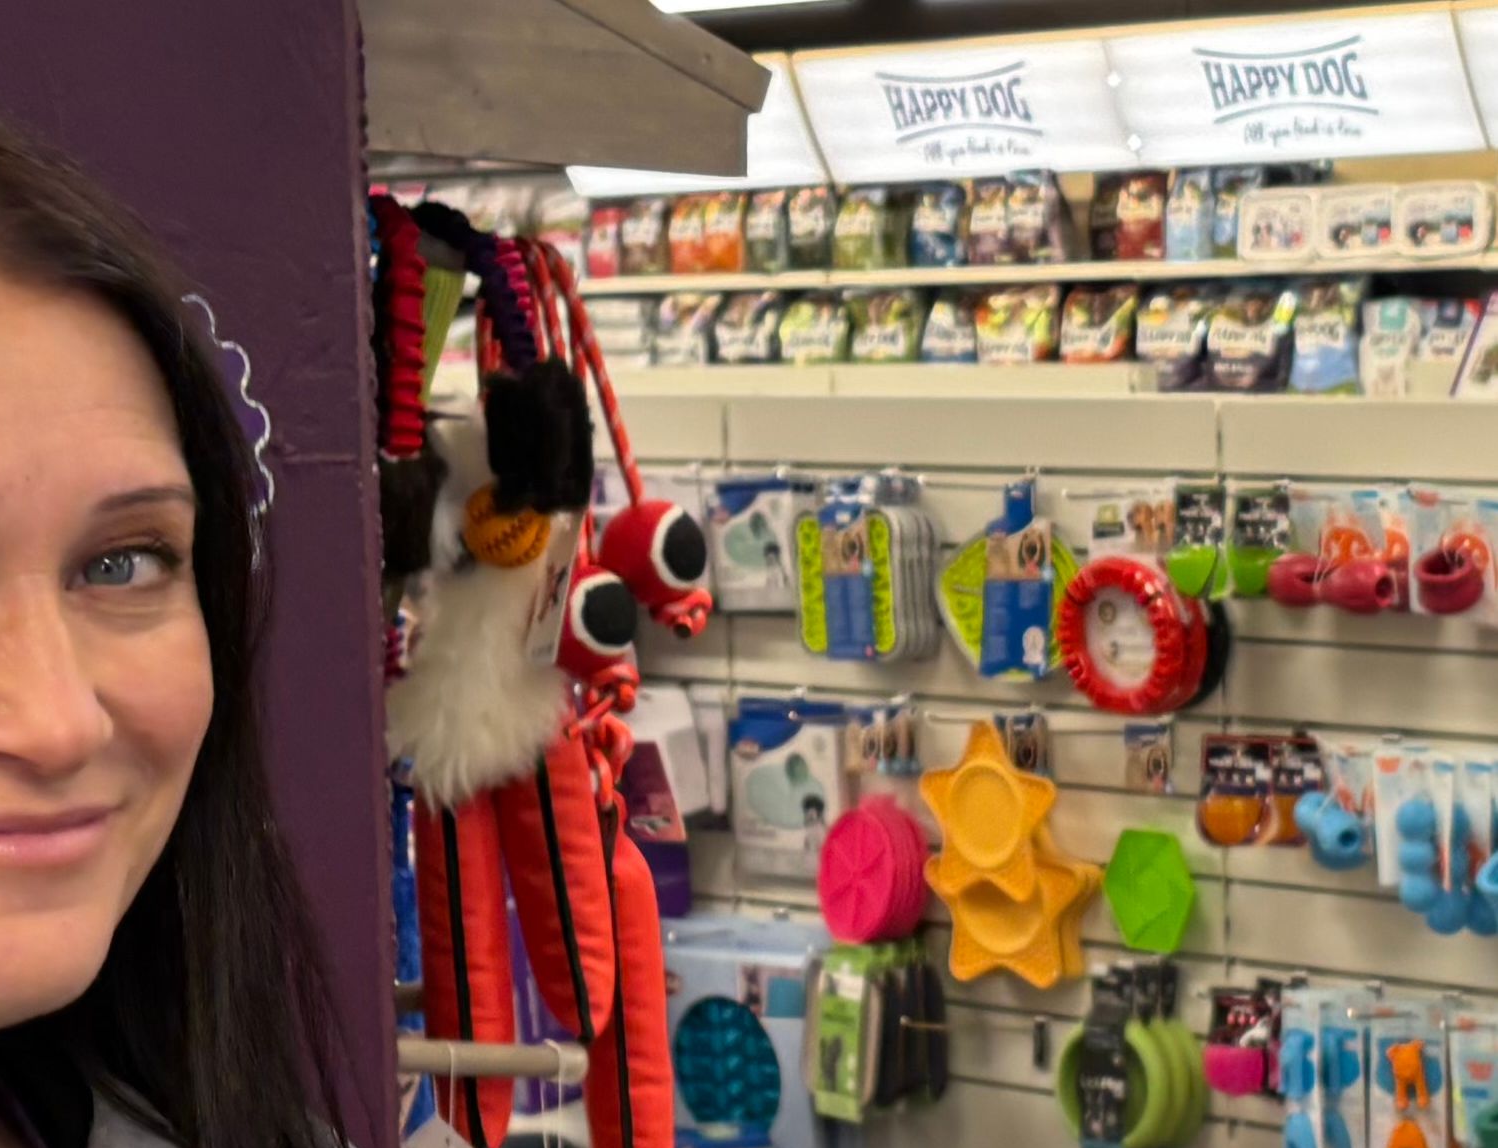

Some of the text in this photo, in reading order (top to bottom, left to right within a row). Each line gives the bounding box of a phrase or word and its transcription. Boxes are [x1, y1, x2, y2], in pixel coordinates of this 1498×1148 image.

[883, 77, 1033, 131] HAPPY DOG
[1202, 51, 1369, 110] HAPPY DOG
